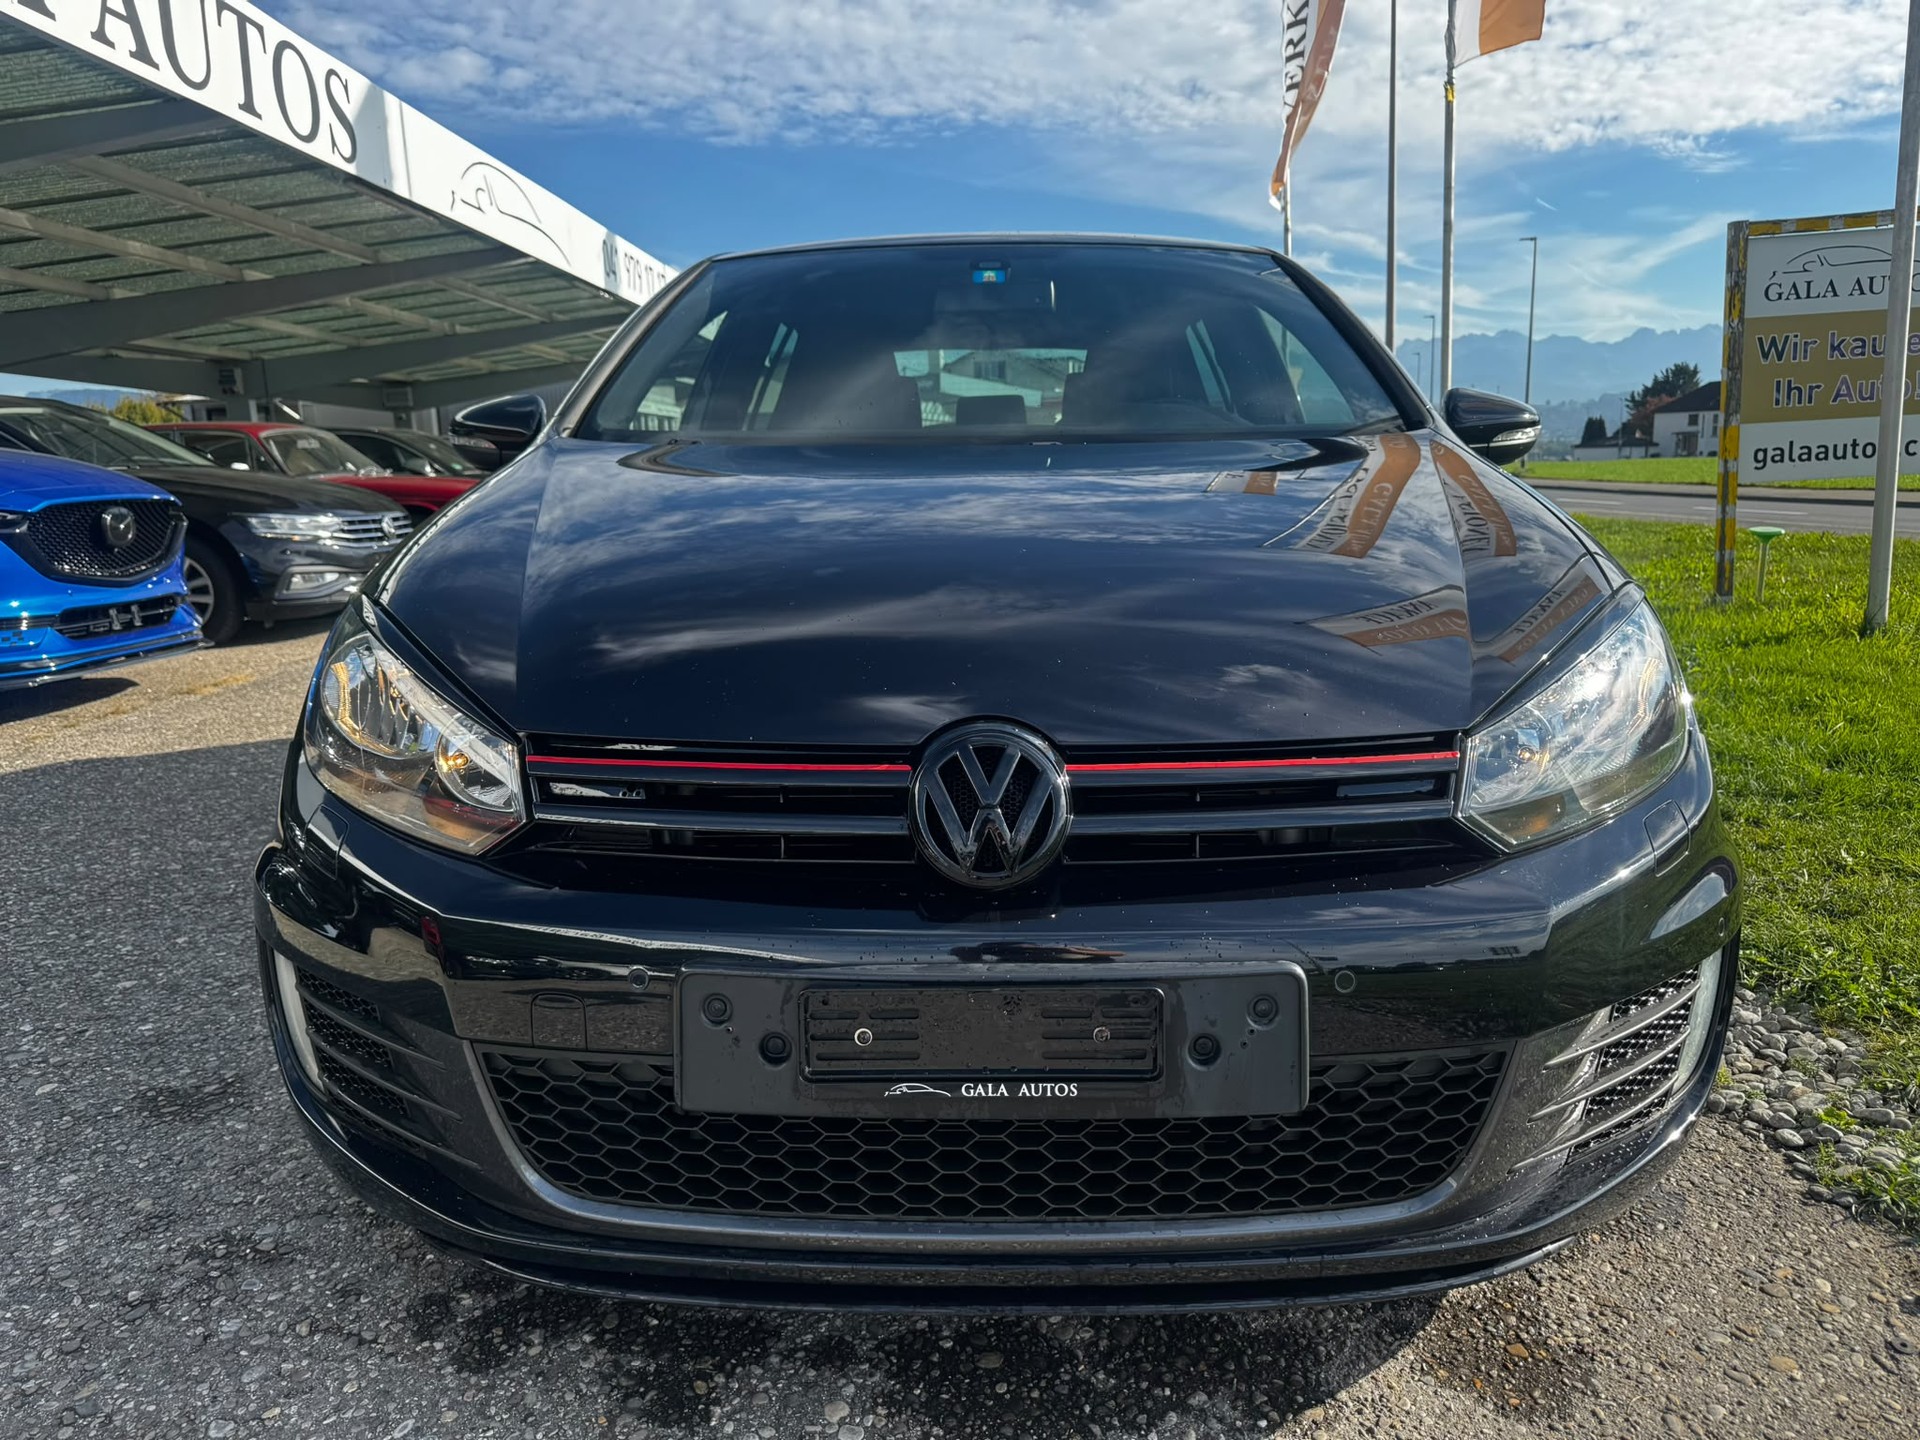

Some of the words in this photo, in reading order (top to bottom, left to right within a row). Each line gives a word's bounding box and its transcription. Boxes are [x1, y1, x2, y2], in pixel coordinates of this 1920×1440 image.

[90, 0, 357, 164] AUTOS
[1764, 277, 1840, 302] GALA
[1756, 332, 1820, 365] Wir
[1827, 330, 1920, 361] kaue
[1772, 377, 1825, 409] Ihr
[961, 1083, 1009, 1097] GALA
[1017, 1083, 1078, 1097] AUTOS
